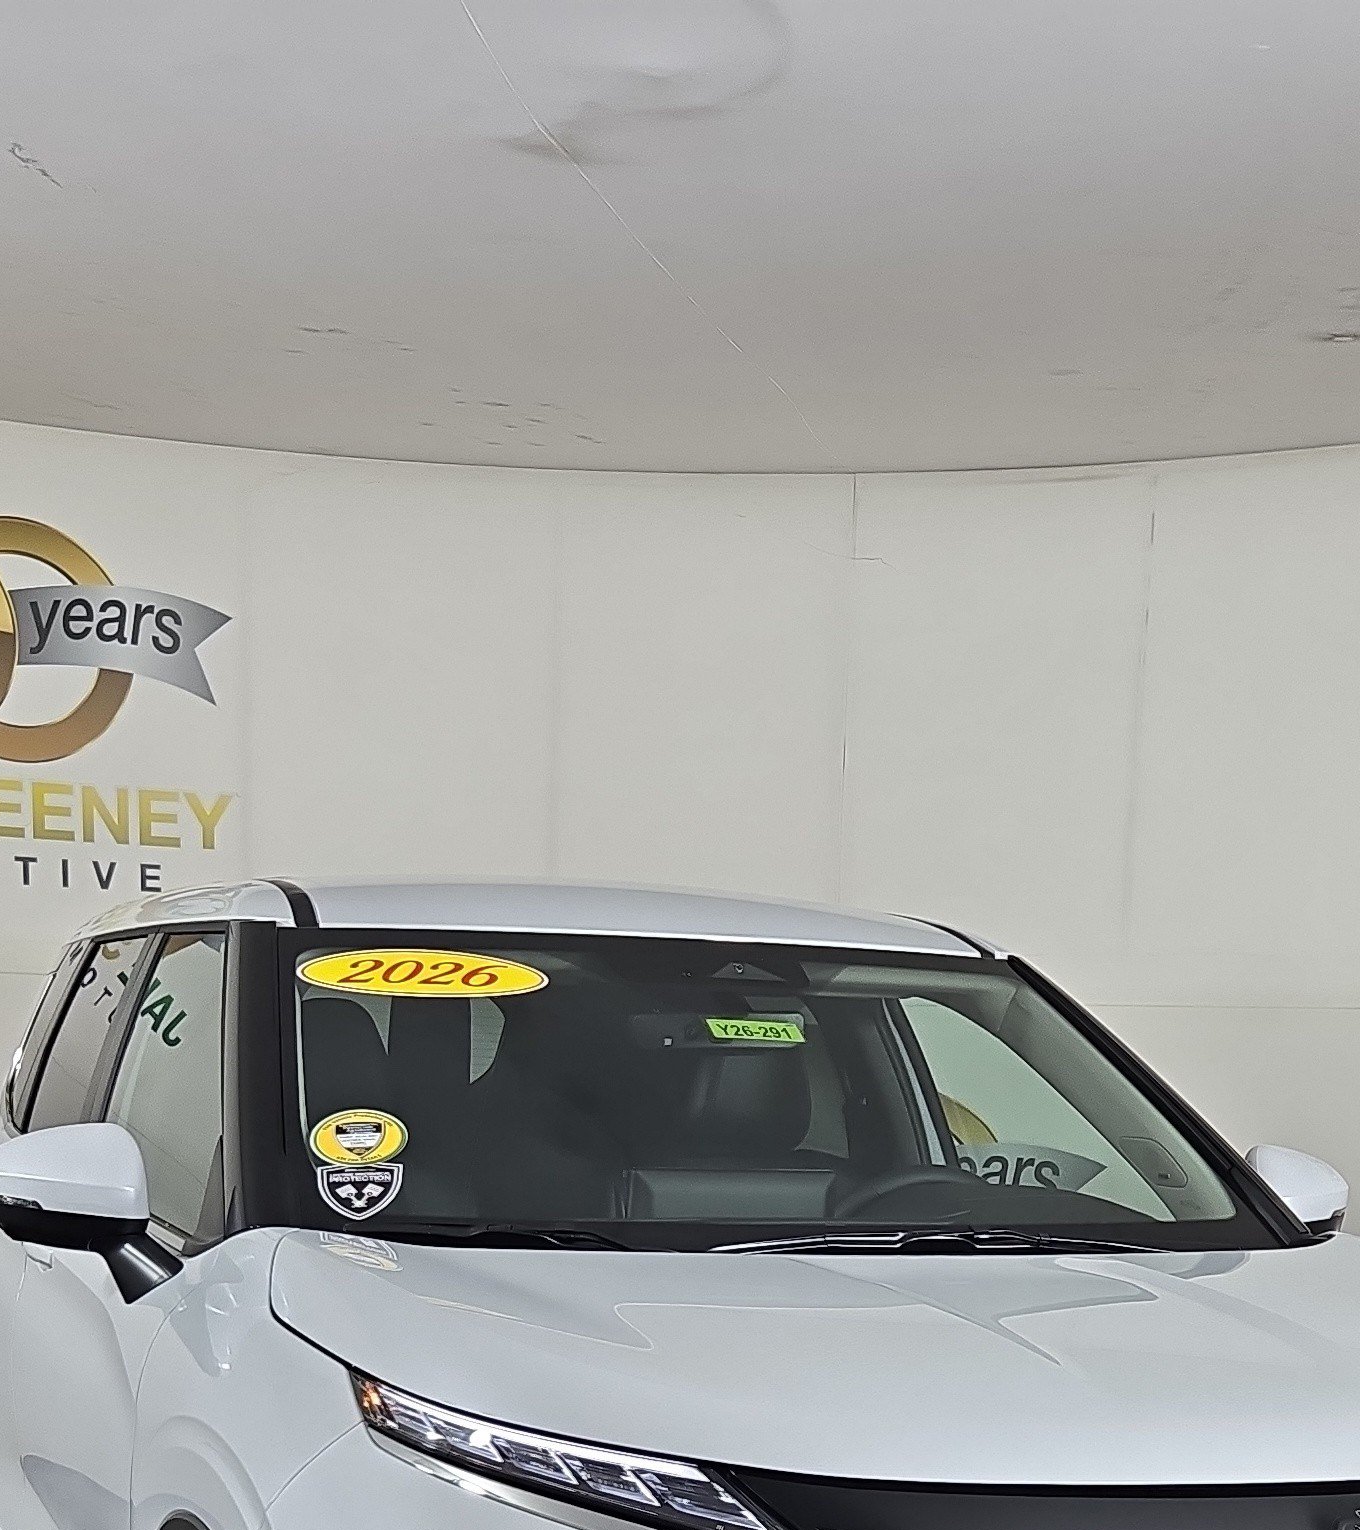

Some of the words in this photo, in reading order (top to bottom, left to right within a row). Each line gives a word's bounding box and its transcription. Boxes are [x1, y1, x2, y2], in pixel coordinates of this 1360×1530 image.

[28, 599, 183, 655] years
[337, 959, 504, 988] 2026
[716, 1023, 793, 1040] Y26-291
